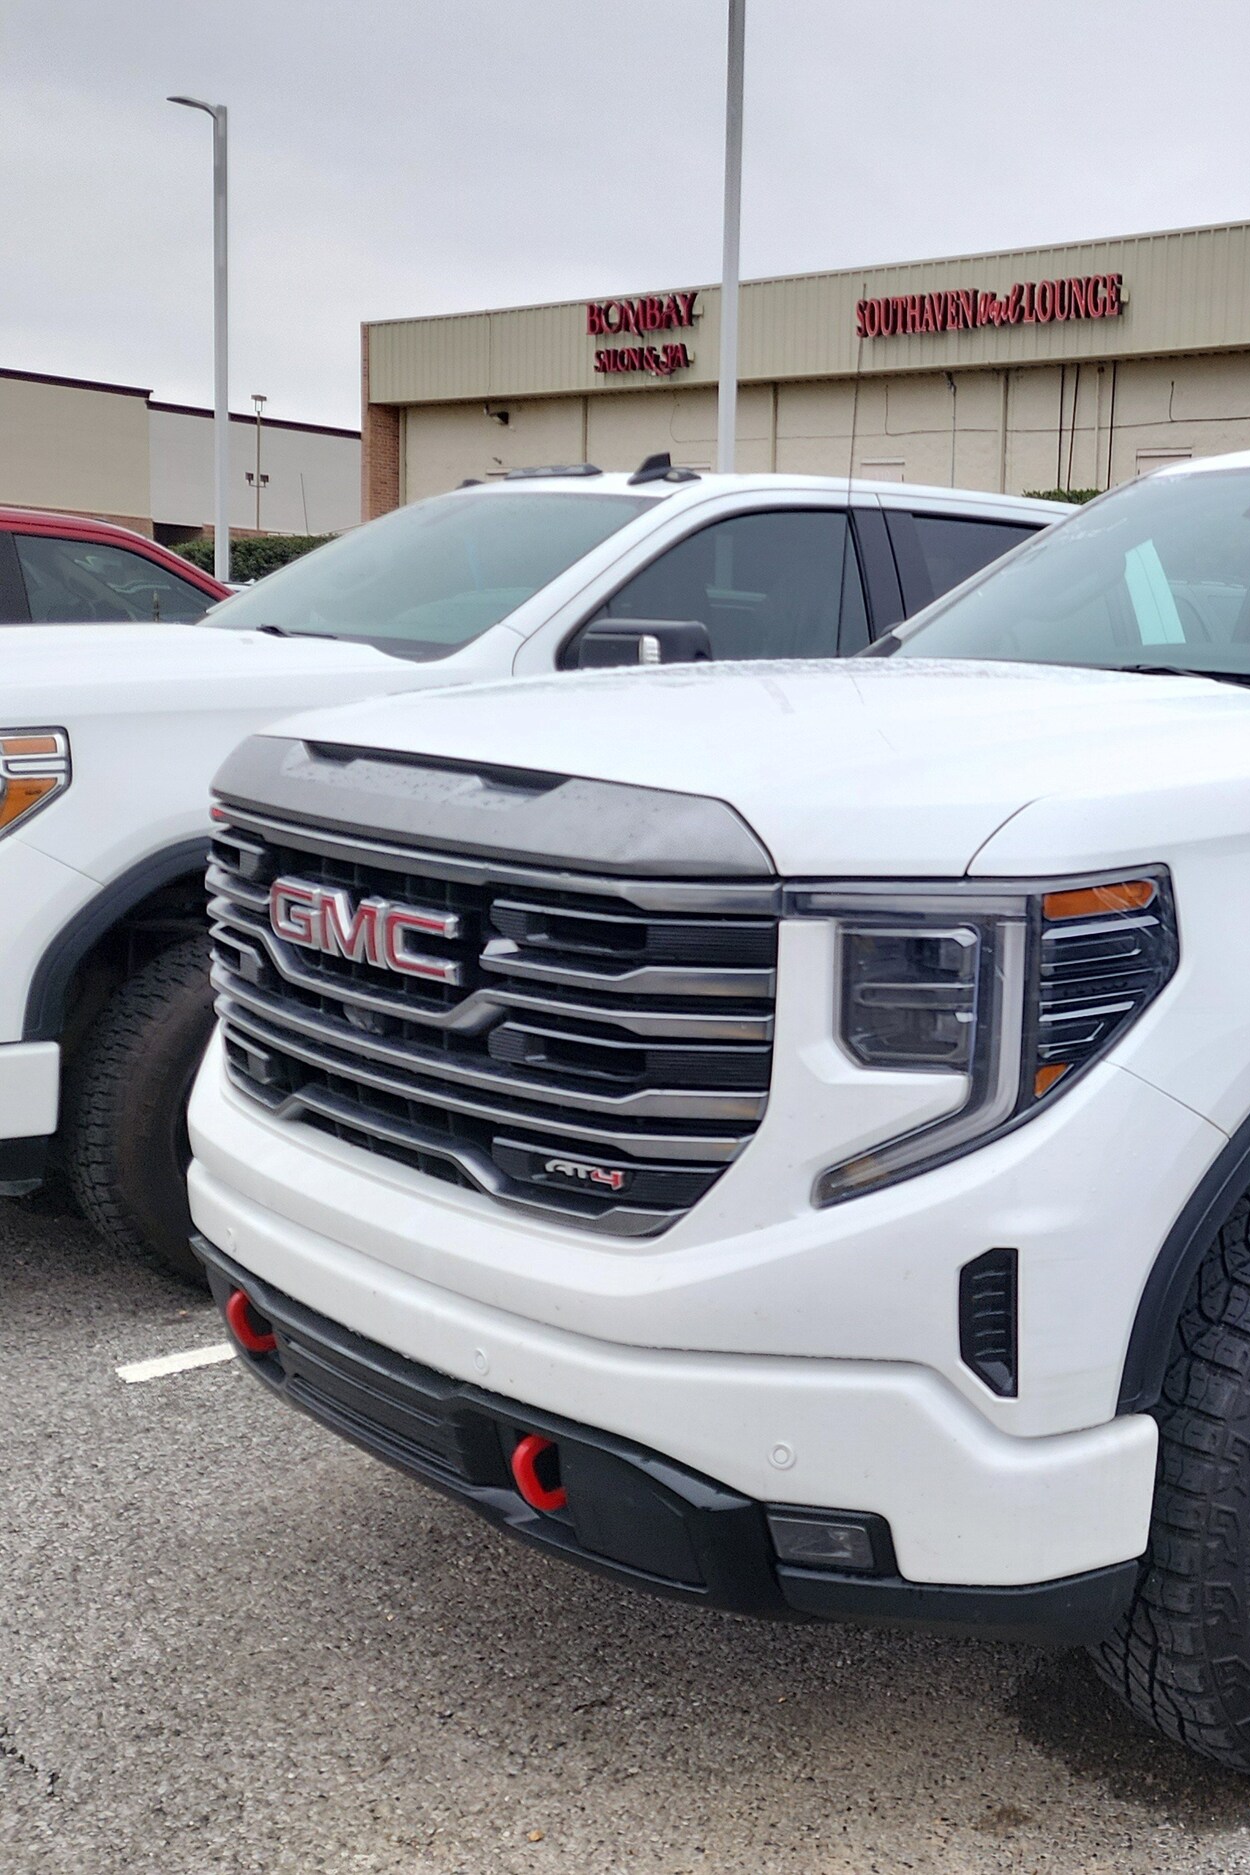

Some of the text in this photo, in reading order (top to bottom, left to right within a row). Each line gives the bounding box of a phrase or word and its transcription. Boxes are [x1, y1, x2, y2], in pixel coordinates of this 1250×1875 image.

[586, 290, 698, 338] BOMBAY
[855, 288, 979, 338] SOUTHAVEN
[1024, 273, 1123, 324] LOUNGE
[594, 346, 645, 373] SALON
[660, 342, 690, 370] SPA
[269, 875, 462, 985] GMC
[545, 1159, 624, 1191] AT4
